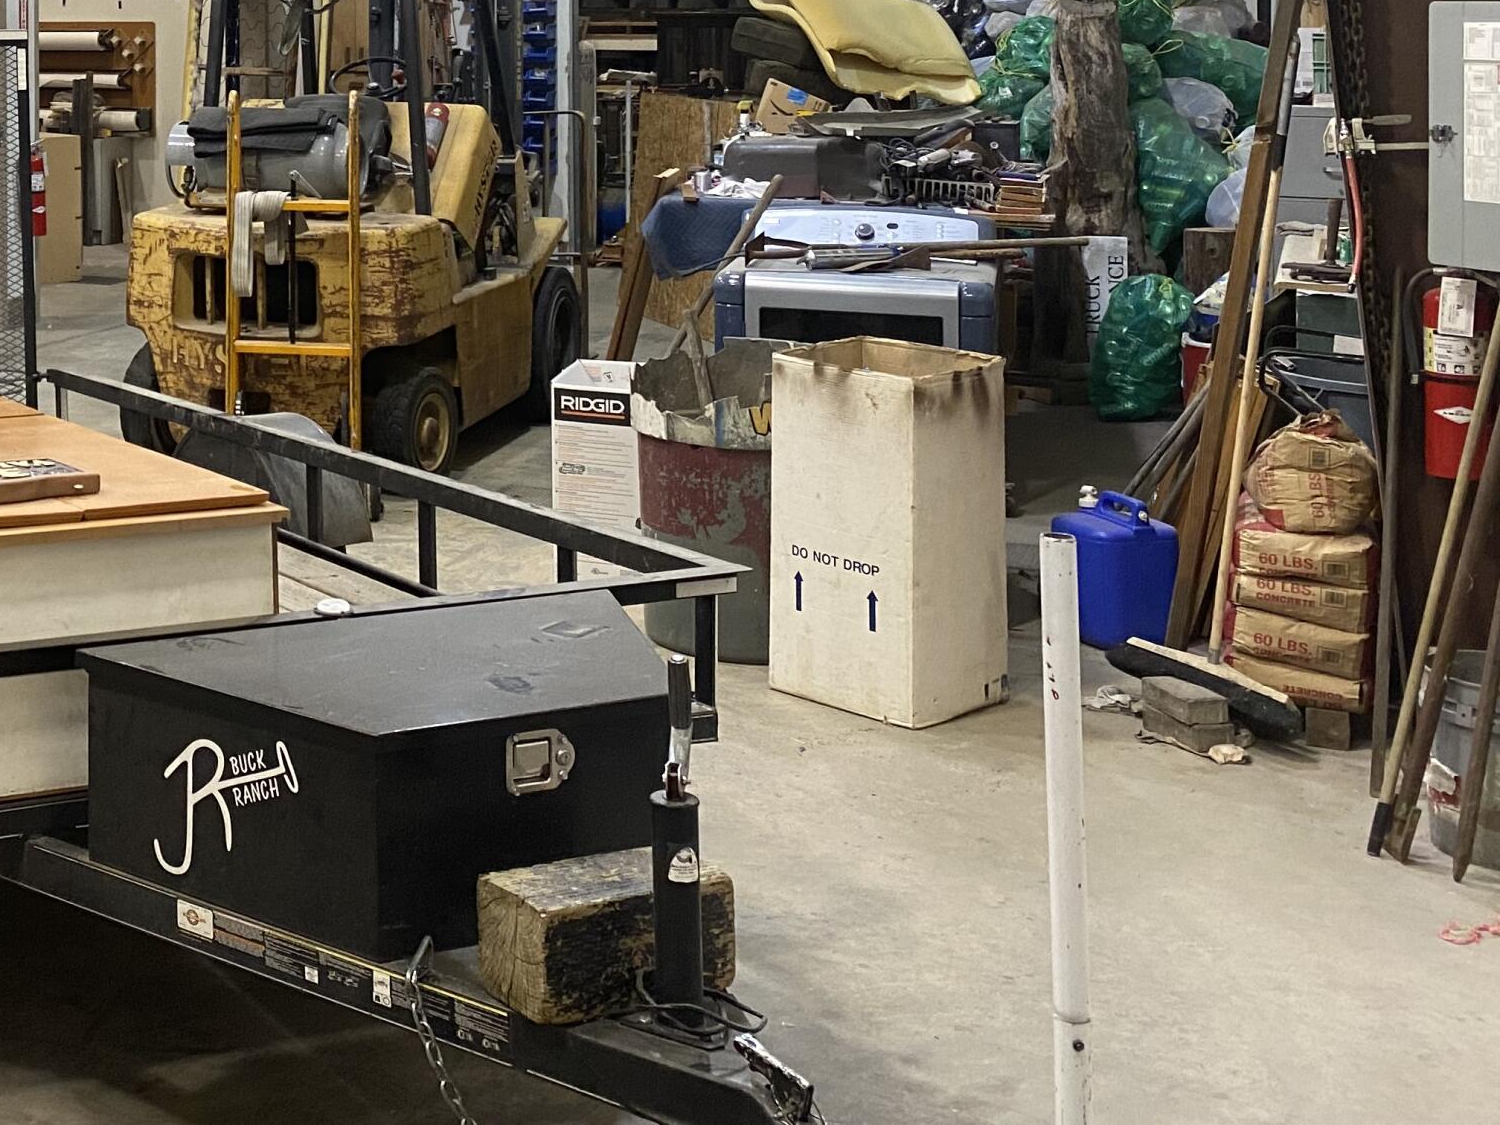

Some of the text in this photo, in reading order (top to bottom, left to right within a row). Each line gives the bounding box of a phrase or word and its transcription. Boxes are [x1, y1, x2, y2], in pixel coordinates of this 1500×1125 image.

[1085, 275, 1101, 335] TRUCK
[561, 395, 625, 414] RIDGID
[791, 544, 880, 576] DO NOT DROP
[1258, 553, 1318, 571] 60 LBS.
[1256, 579, 1316, 597] 60 LBS.
[1256, 592, 1316, 608] CONCRETE
[1253, 633, 1312, 656] 60 LBS.
[229, 749, 267, 775] BUCK
[232, 777, 280, 807] RANCH
